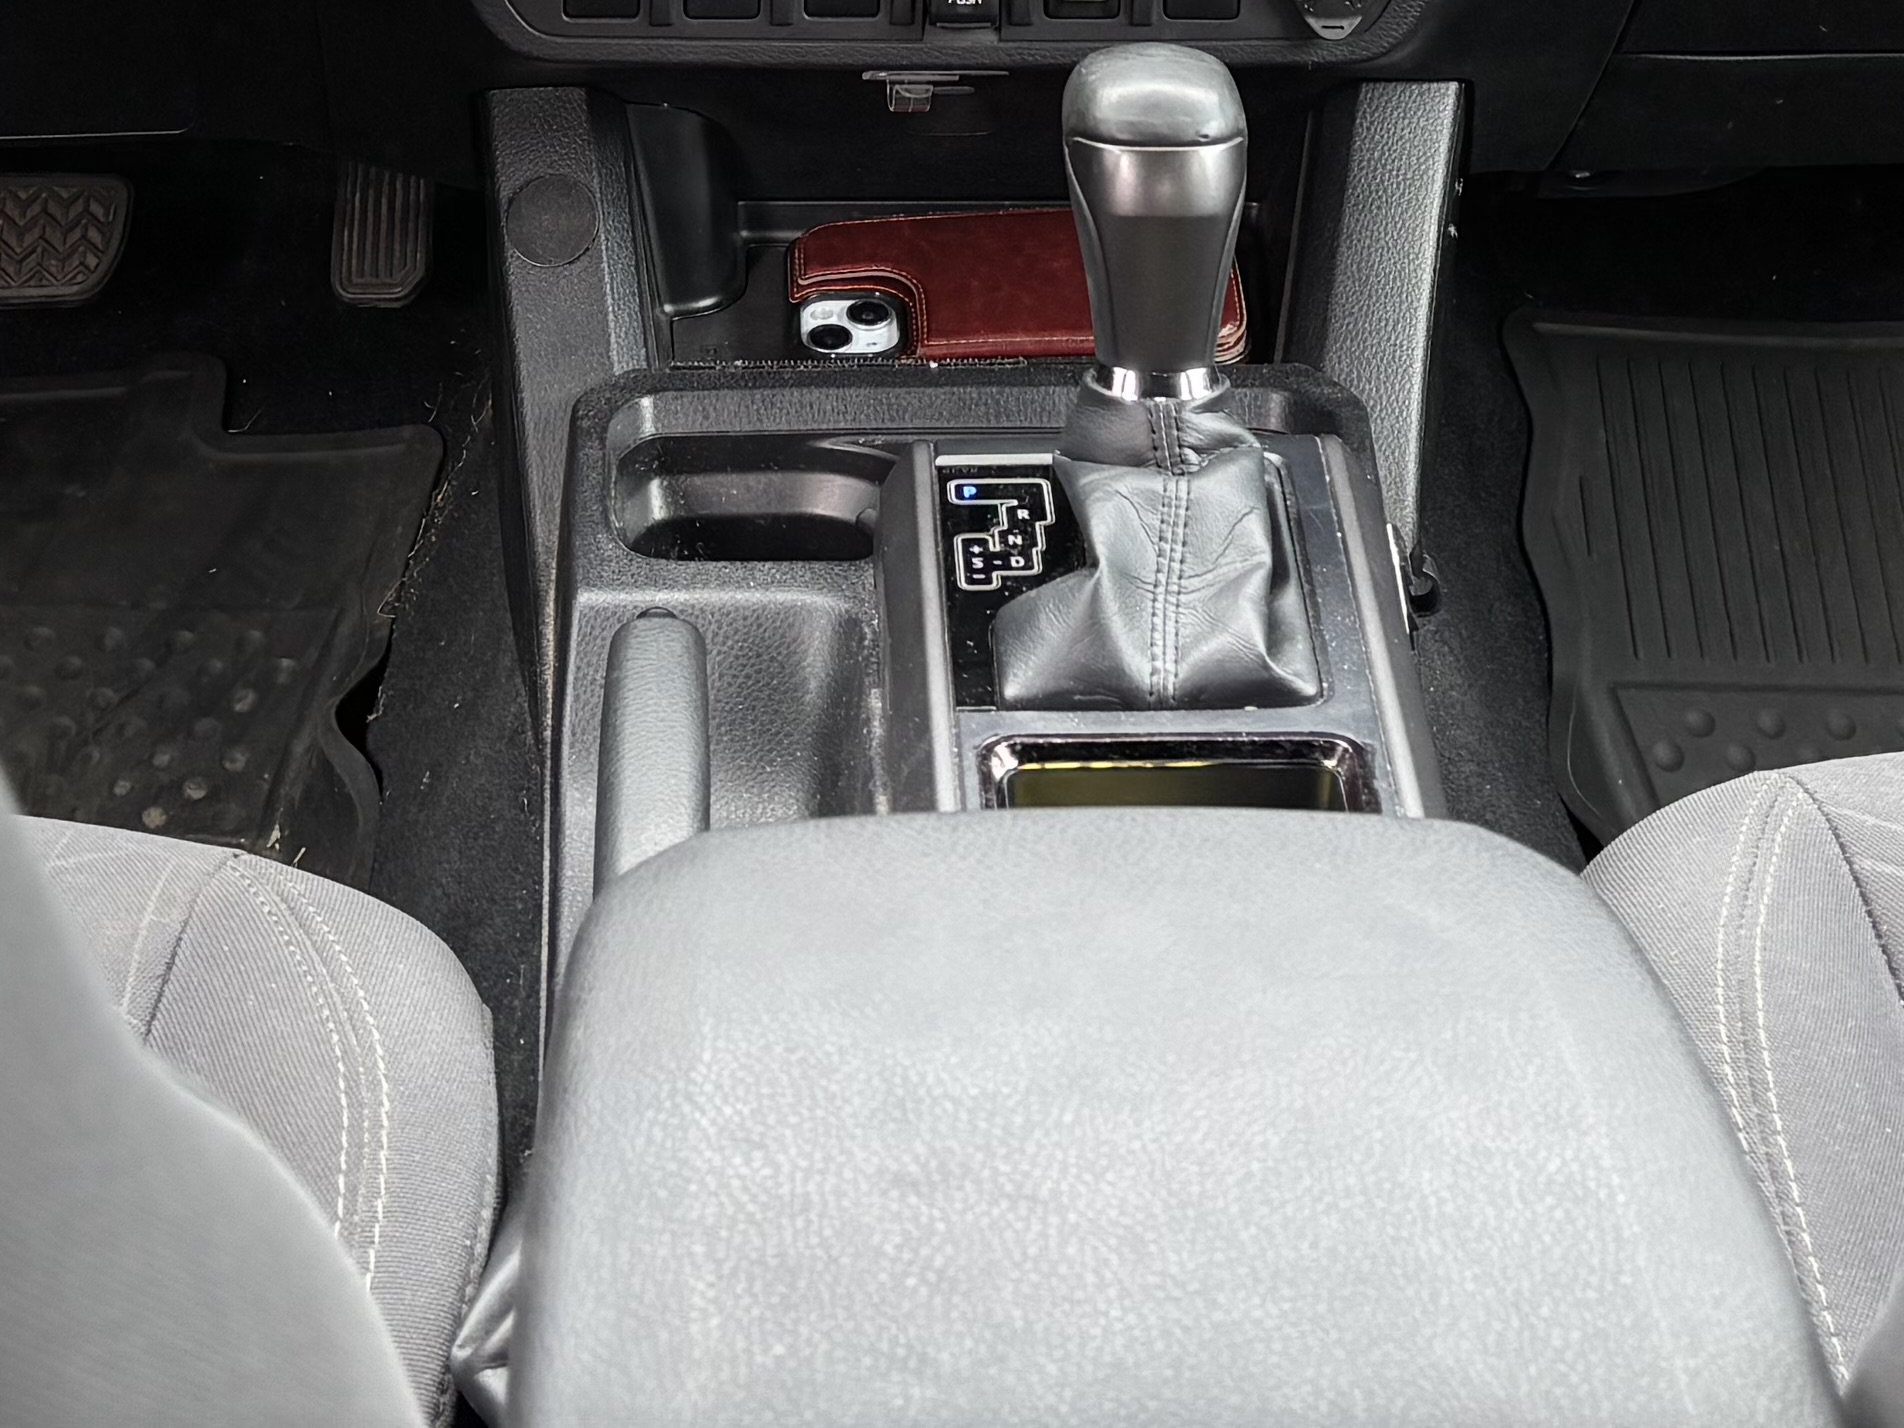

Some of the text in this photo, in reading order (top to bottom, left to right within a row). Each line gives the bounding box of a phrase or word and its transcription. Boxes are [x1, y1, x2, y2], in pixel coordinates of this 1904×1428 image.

[962, 485, 977, 499] P
[1017, 508, 1031, 520] R
[1007, 534, 1023, 546] N
[971, 556, 984, 569] S
[1009, 555, 1025, 568] D
